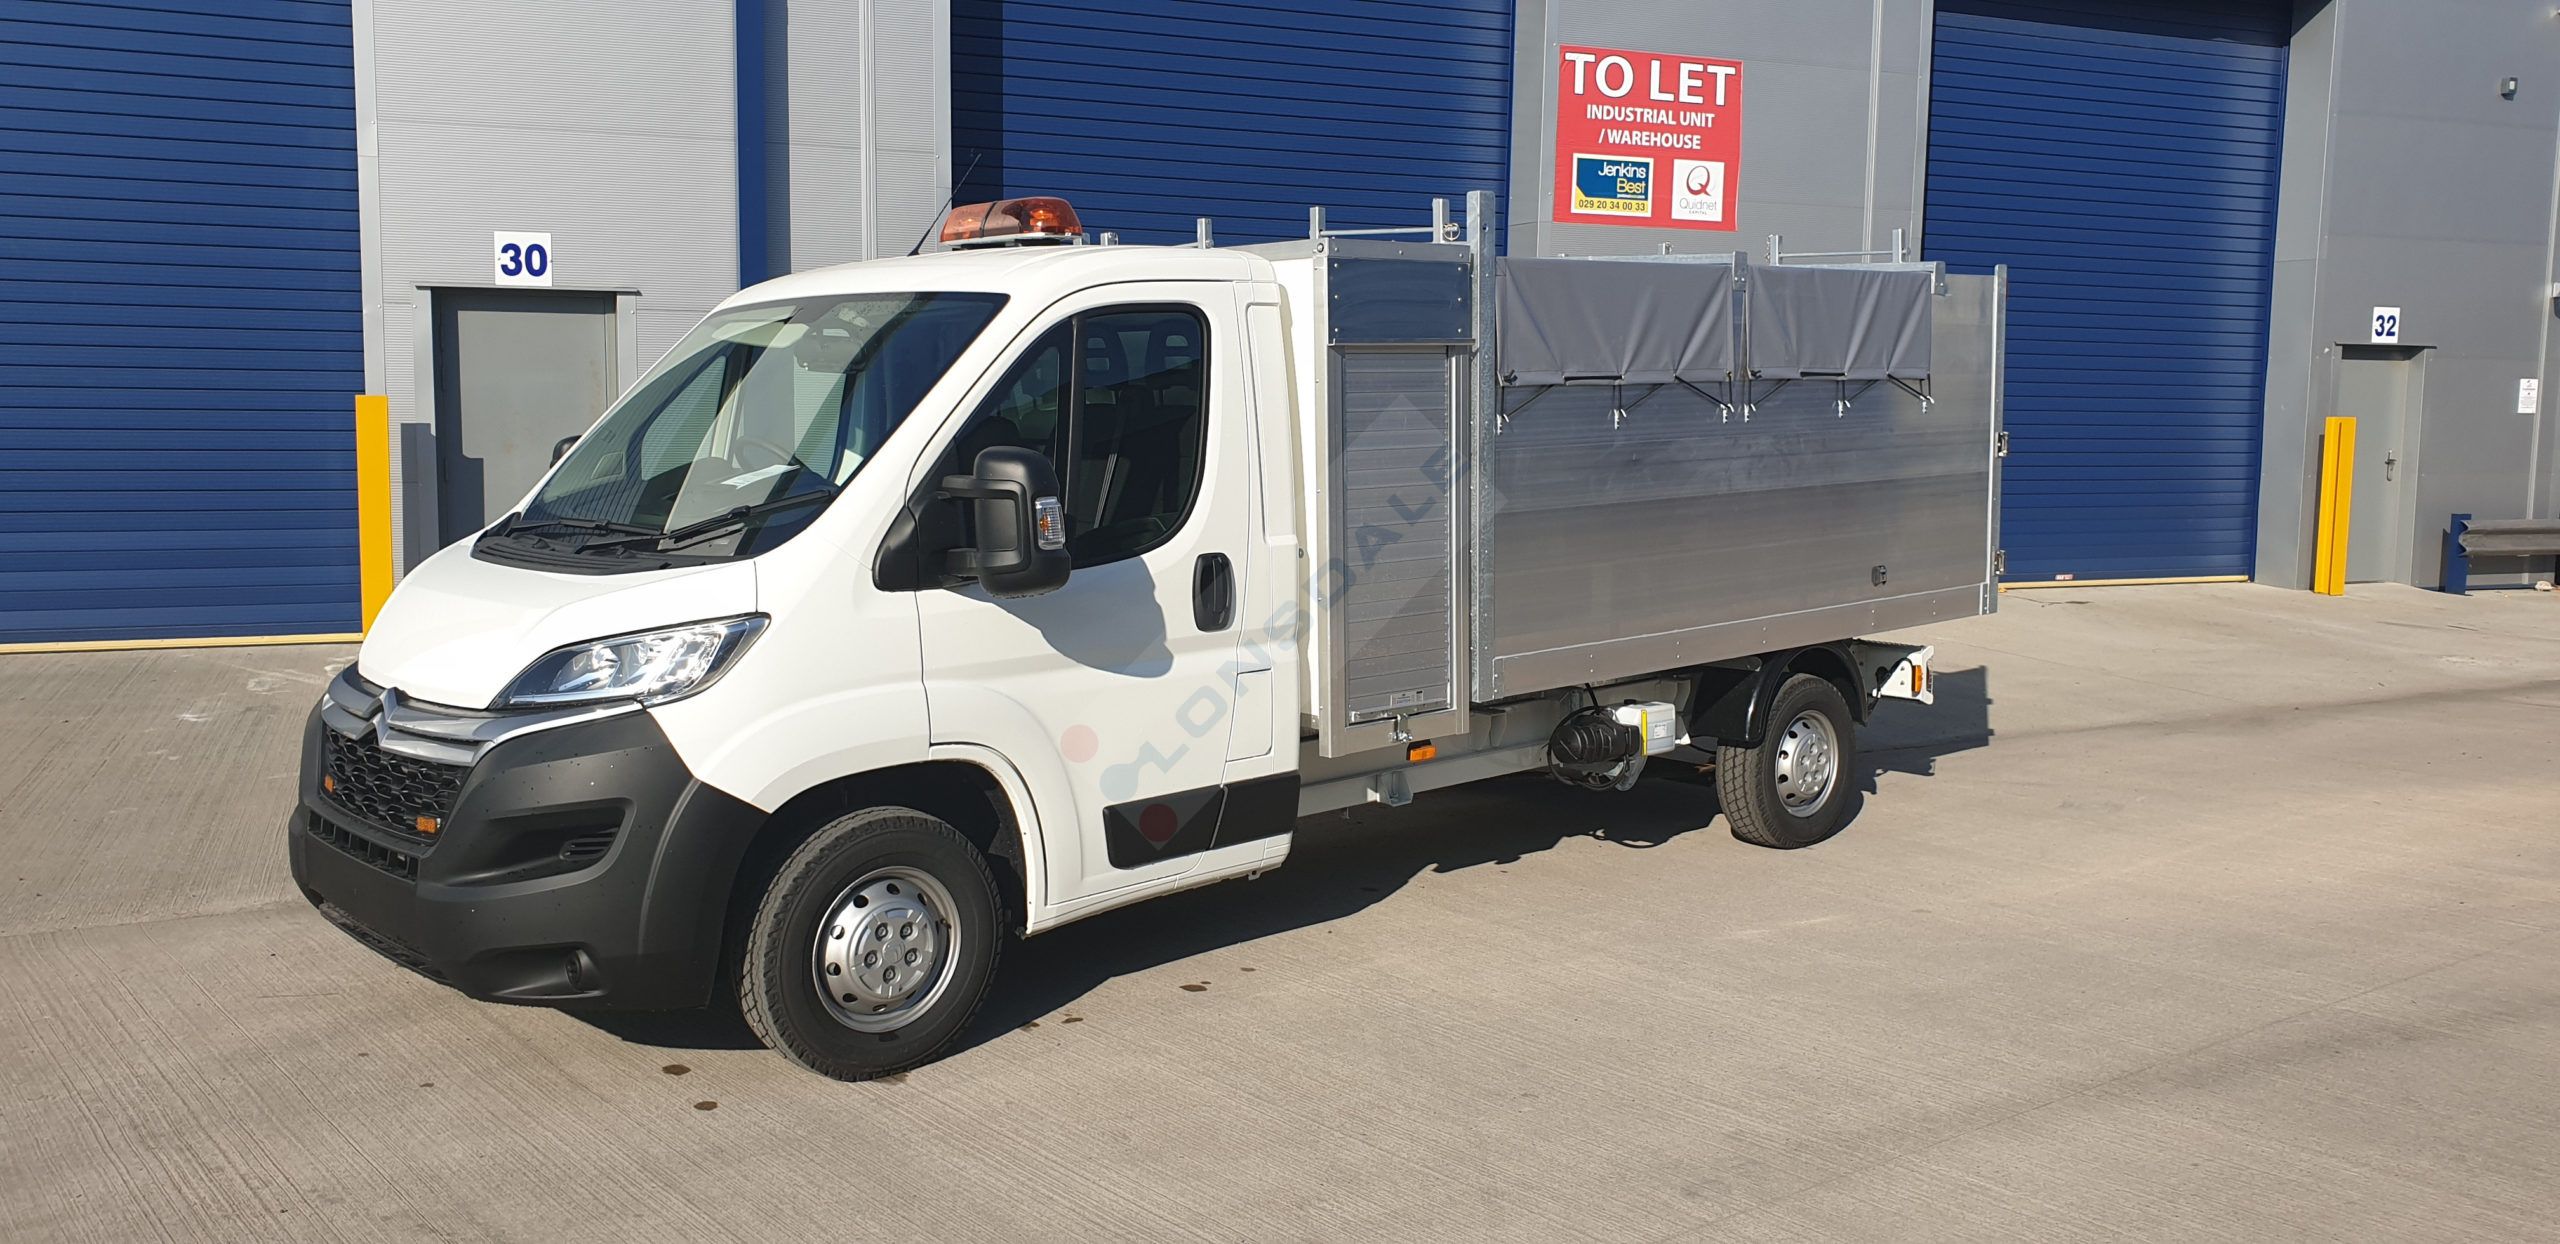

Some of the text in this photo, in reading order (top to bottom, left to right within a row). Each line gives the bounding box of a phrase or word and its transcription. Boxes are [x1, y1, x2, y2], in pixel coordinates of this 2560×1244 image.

[1564, 52, 1737, 106] TO LET
[1586, 104, 1715, 128] INDUSTRIAL UNIT
[1598, 162, 1647, 179] Jenkins
[1616, 178, 1646, 194] Best
[1578, 199, 1646, 211] 029 20 34 00 33
[500, 243, 548, 277] 30
[2374, 314, 2397, 337] 32
